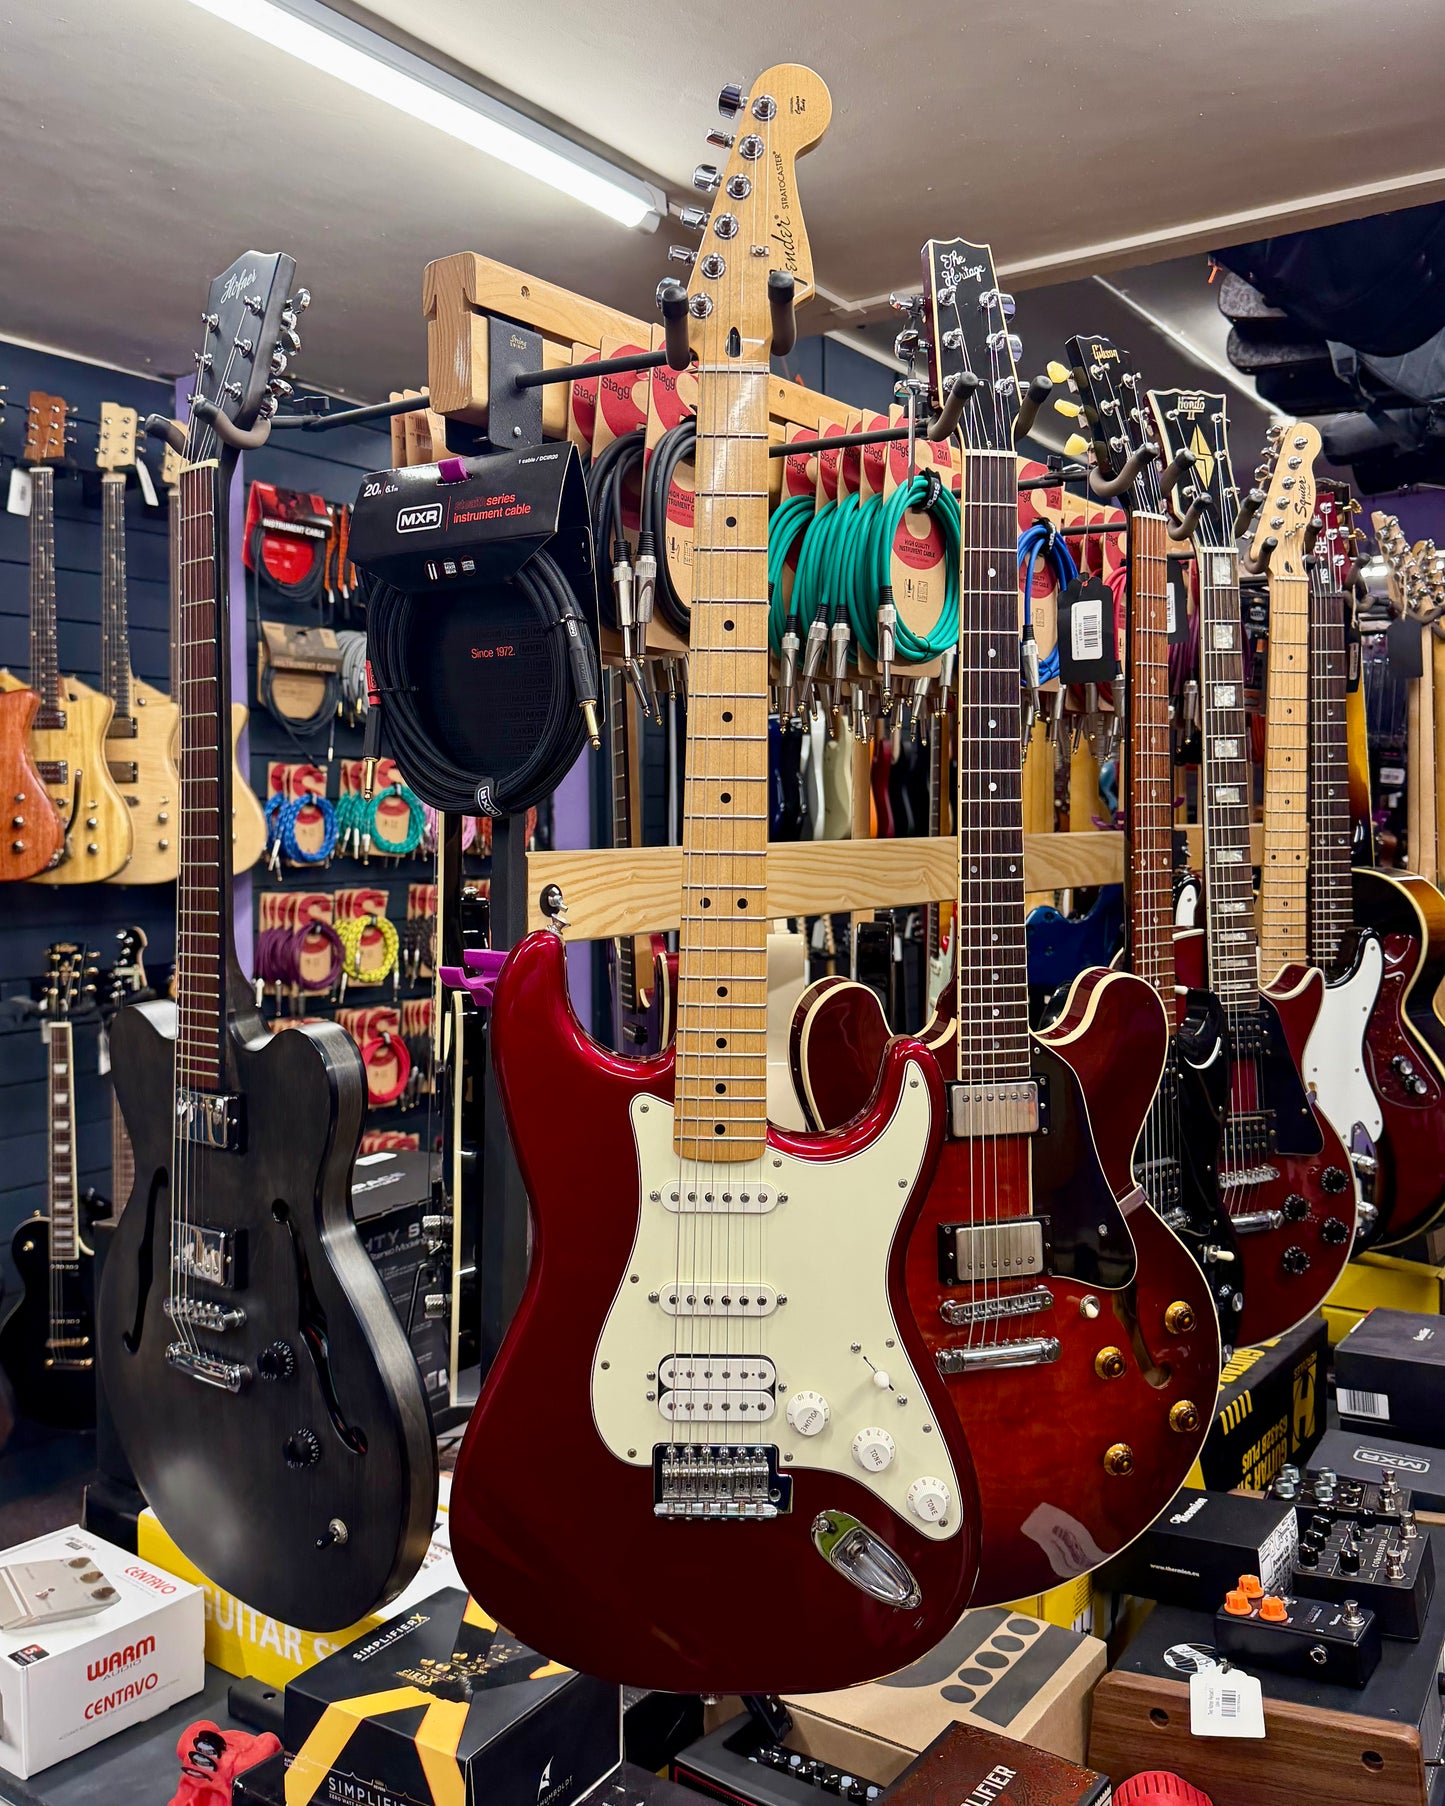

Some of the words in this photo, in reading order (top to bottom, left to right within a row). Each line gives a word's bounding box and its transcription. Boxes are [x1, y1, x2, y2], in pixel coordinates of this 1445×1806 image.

[940, 250, 966, 270] The
[942, 264, 986, 287] Heritage
[1092, 345, 1120, 365] Gibson
[601, 377, 631, 399] Stagg
[653, 366, 676, 391] Stagg
[1178, 396, 1205, 412] Hondo
[787, 455, 806, 474] Stagg
[1295, 476, 1308, 517] Squier
[400, 512, 438, 527] MXR
[453, 510, 503, 524] instrument
[504, 503, 531, 517] cable
[263, 518, 304, 535] INSTRUMENT
[304, 525, 326, 539] CABLE
[471, 648, 494, 659] Since
[316, 662, 338, 673] CABLE
[481, 789, 499, 815] MXR
[800, 1410, 821, 1433] VOLUME
[870, 1449, 883, 1466] TONE
[1361, 1450, 1423, 1471] MXR
[926, 1498, 938, 1516] TONE
[124, 1566, 177, 1595] CENTAVO
[87, 1635, 156, 1682] WARM
[102, 1658, 142, 1682] AUDIO
[84, 1673, 159, 1721] CENTAVO
